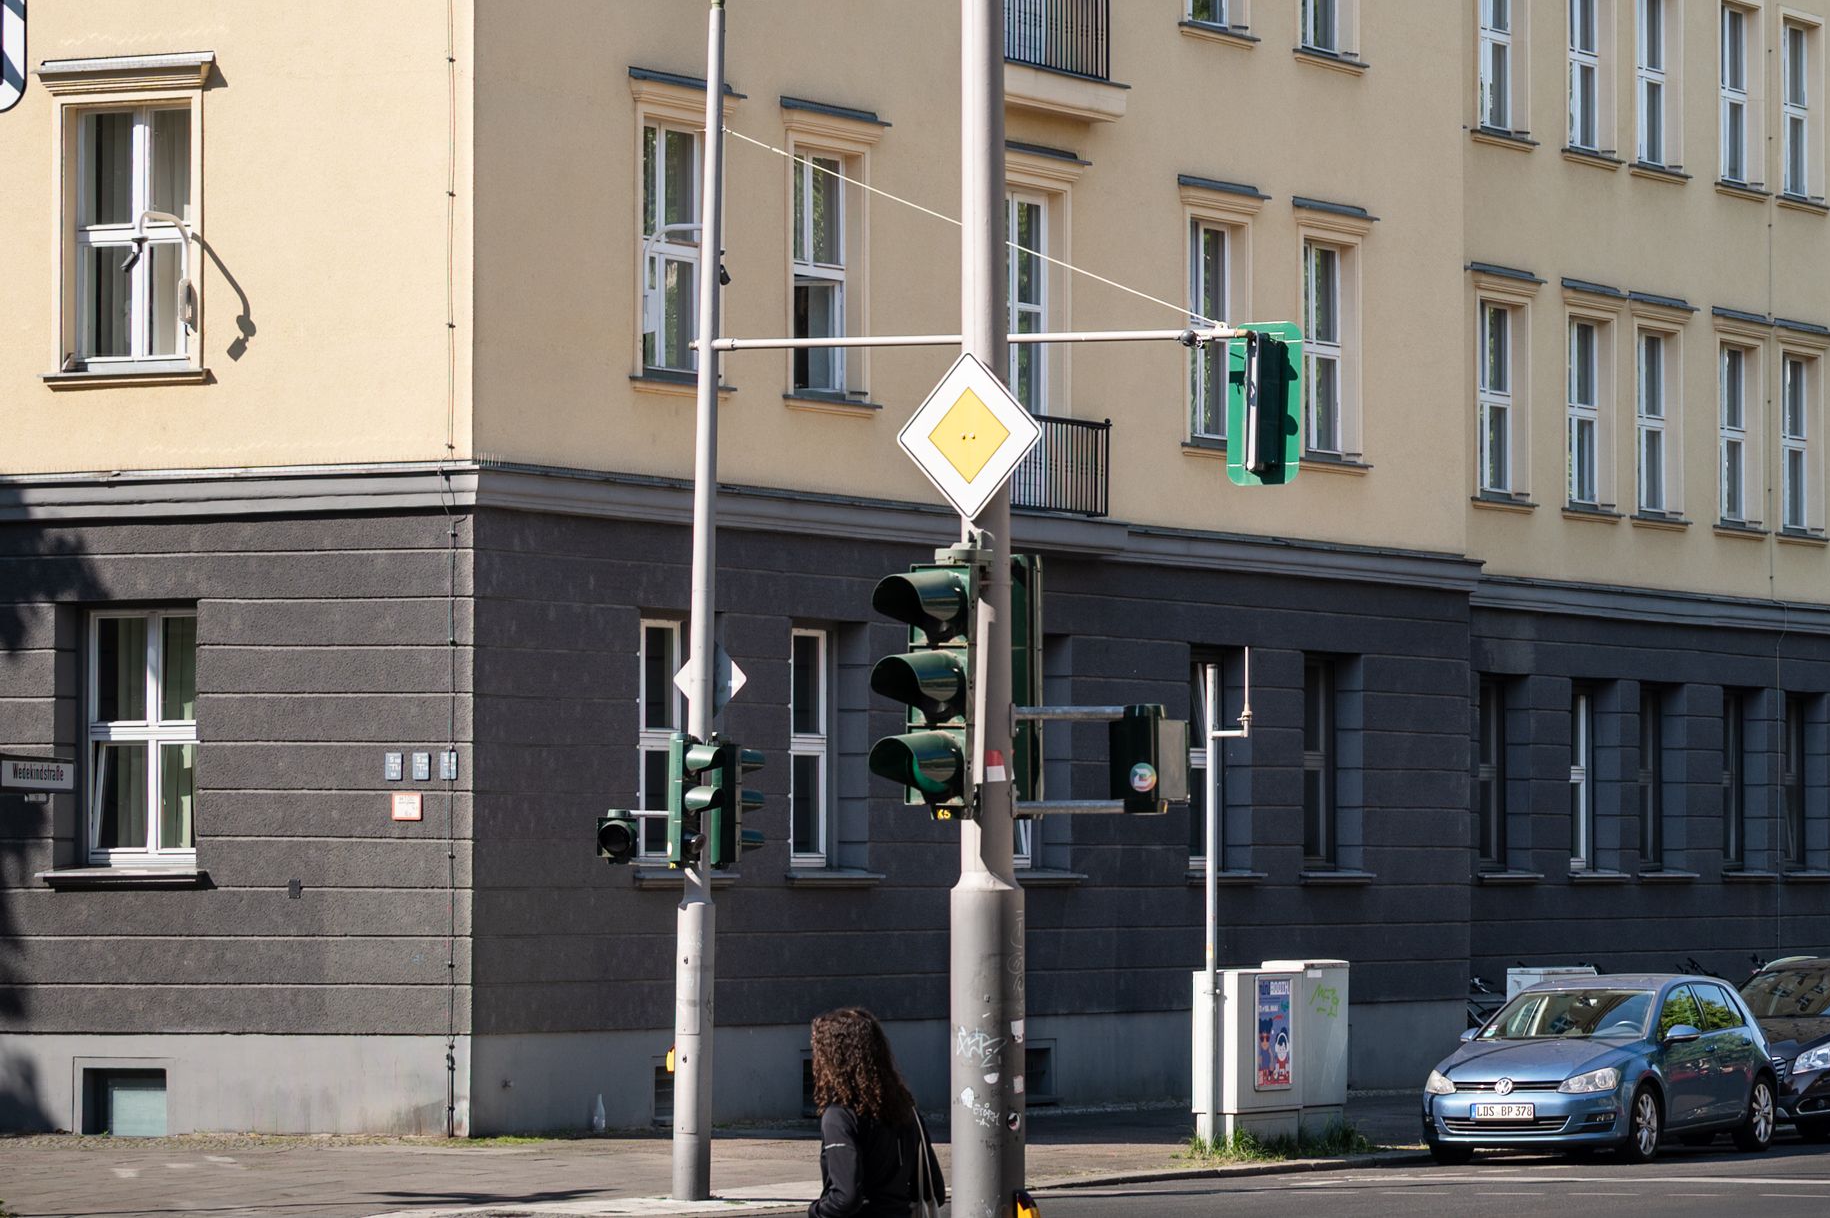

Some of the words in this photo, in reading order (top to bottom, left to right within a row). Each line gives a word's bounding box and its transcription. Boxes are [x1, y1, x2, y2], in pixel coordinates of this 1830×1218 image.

[12, 762, 65, 781] Wedekindstraße
[1477, 1105, 1495, 1117] LDS
[1501, 1105, 1513, 1117] BP
[1515, 1105, 1533, 1117] 378
